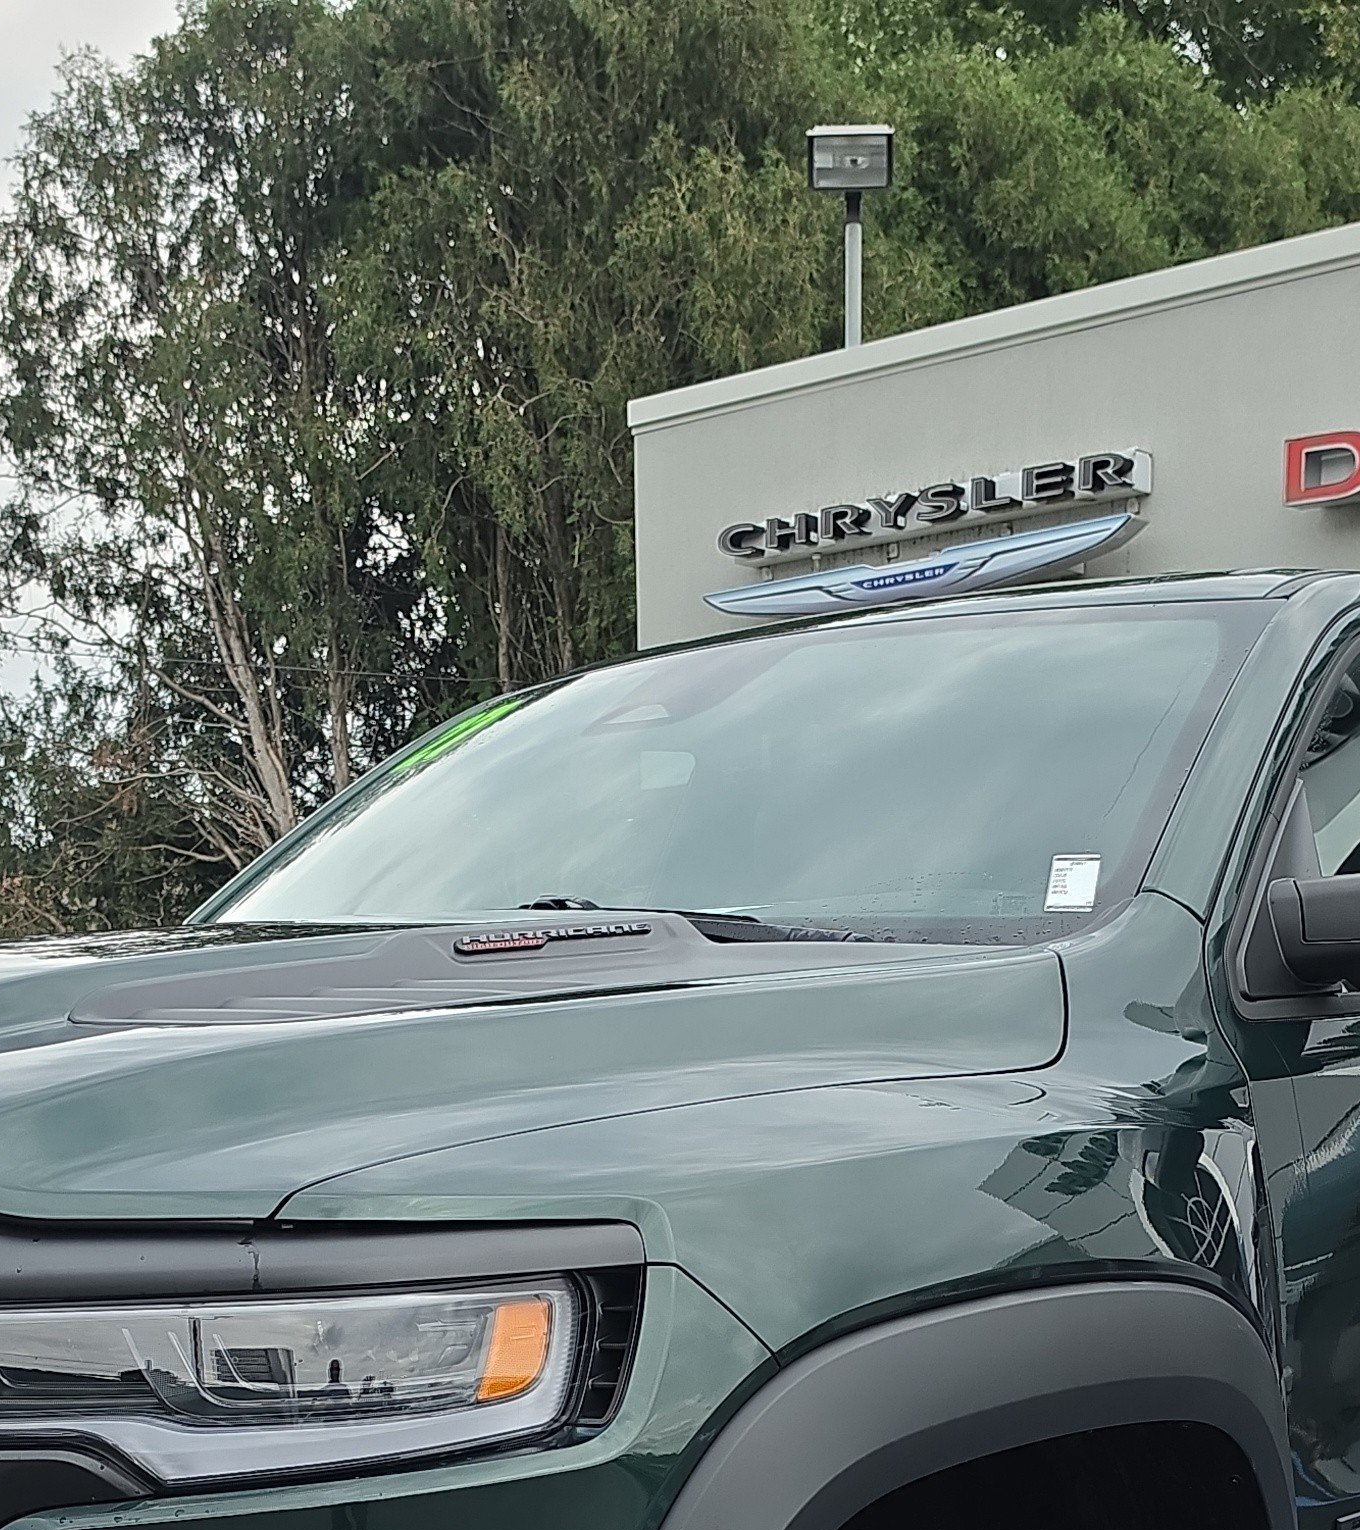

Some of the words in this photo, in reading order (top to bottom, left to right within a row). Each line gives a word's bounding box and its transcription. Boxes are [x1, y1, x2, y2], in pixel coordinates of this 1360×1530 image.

[717, 452, 1135, 558] CHRYSLER
[861, 566, 947, 590] CHRYSLER
[461, 922, 651, 943] HURRICANE
